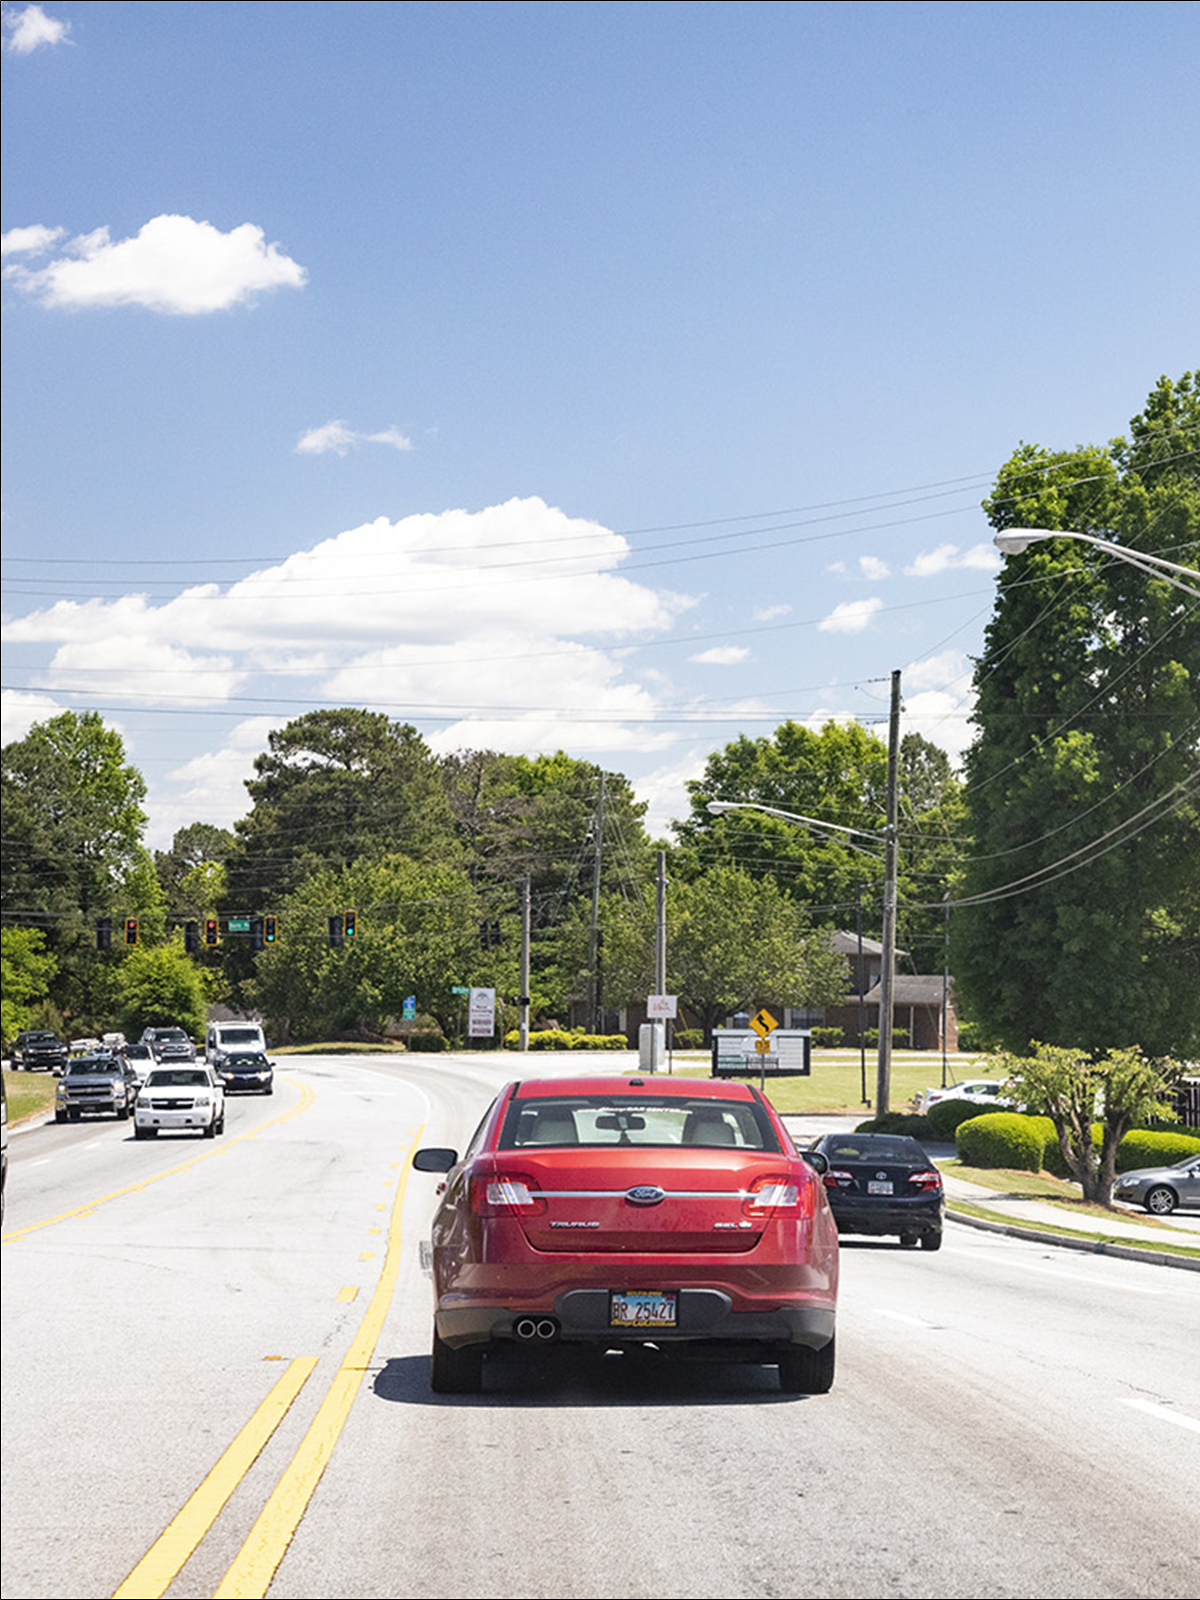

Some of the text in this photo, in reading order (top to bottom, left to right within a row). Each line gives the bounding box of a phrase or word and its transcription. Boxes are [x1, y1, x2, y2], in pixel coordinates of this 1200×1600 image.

[634, 1189, 657, 1199] Ford
[613, 1302, 674, 1320] BR 25427
